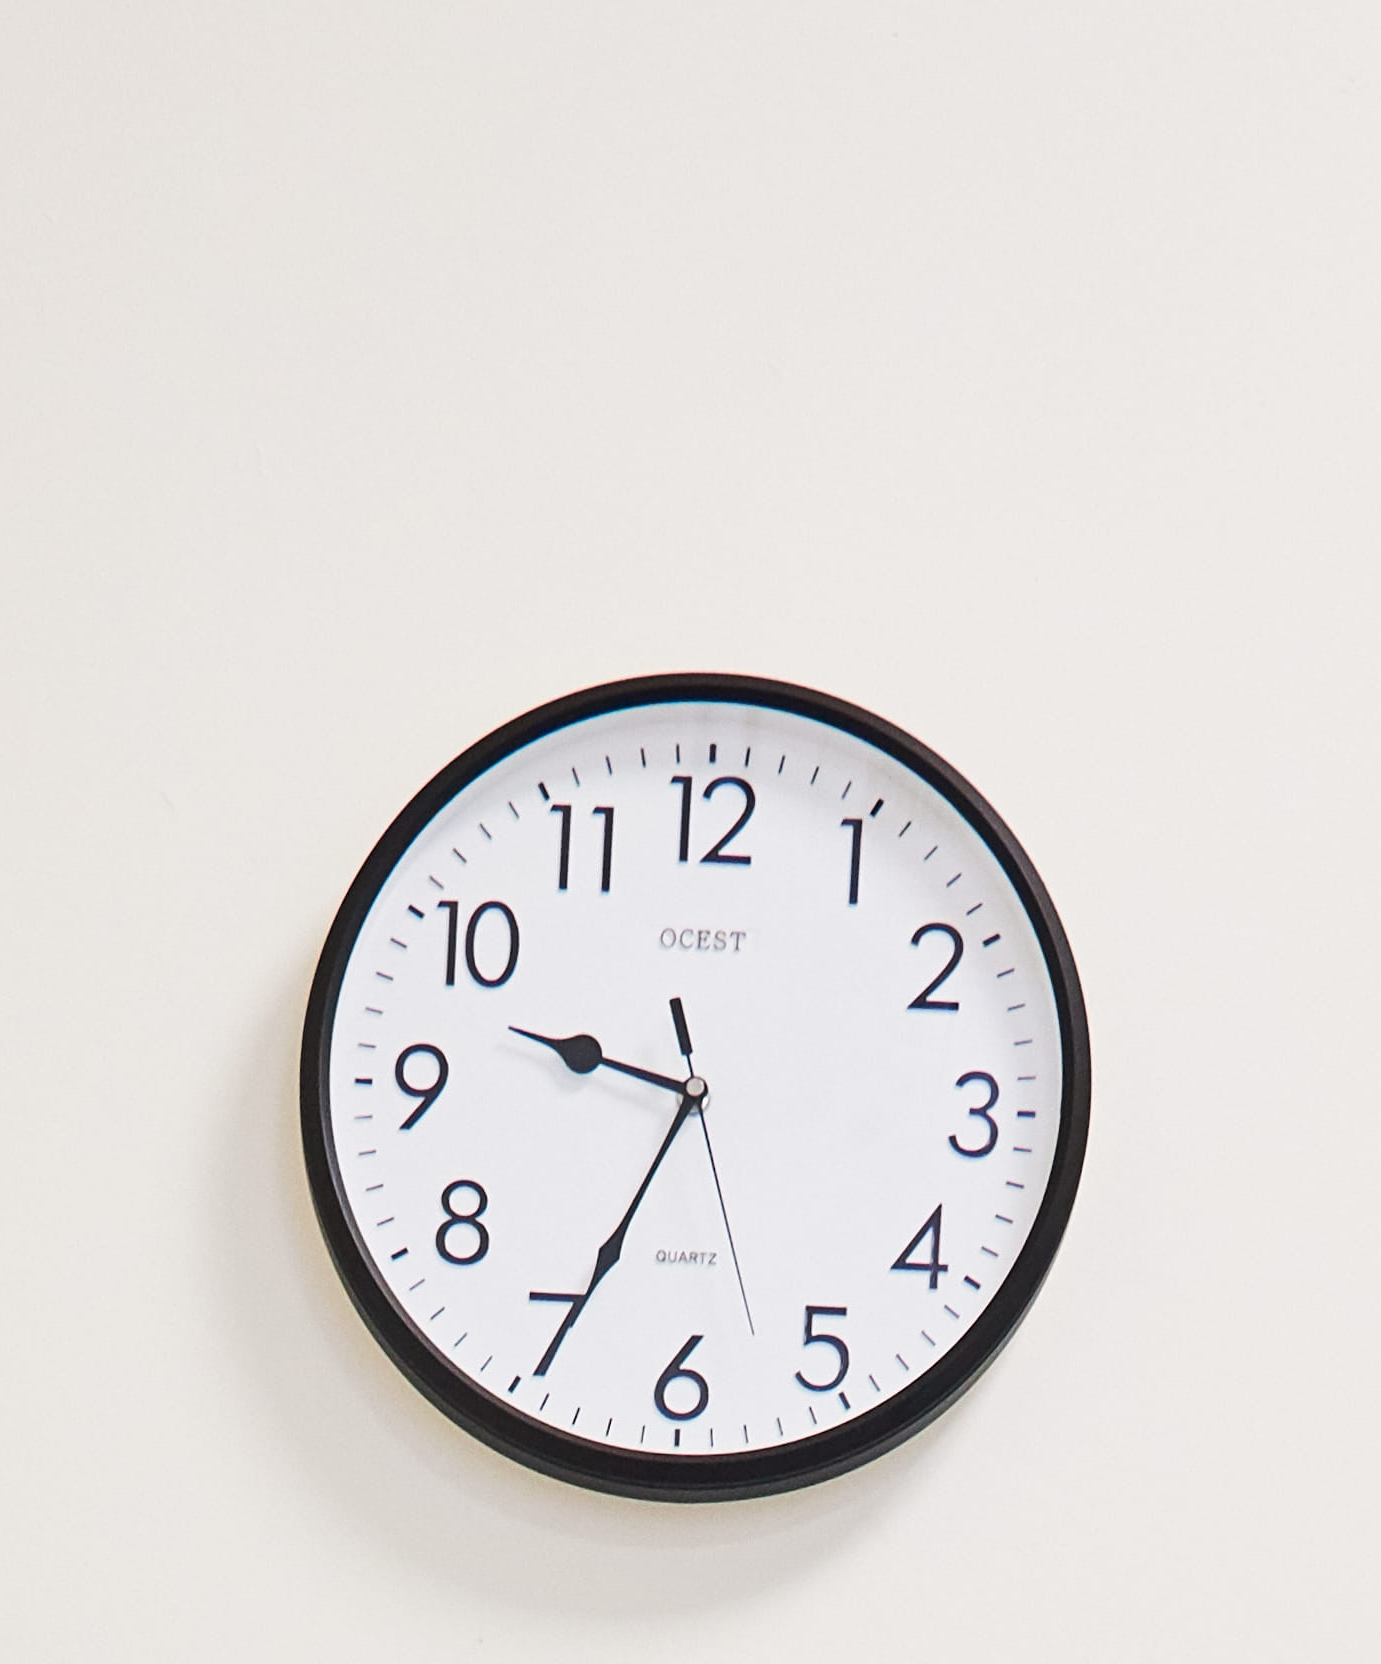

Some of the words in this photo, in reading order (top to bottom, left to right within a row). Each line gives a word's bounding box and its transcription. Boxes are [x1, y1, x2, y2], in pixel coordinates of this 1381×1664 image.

[551, 804, 616, 892] 11
[671, 775, 757, 866] 12
[841, 818, 864, 905] 1
[437, 900, 521, 988] 10
[660, 928, 747, 951] OCEST
[907, 923, 965, 1011] 2
[395, 1044, 449, 1131] 9
[948, 1072, 1000, 1158] 3
[435, 1180, 490, 1265] 8
[656, 1249, 717, 1265] QUARTZ
[891, 1203, 949, 1290] 4
[529, 1292, 586, 1377] 7
[795, 1306, 850, 1392] 5
[653, 1335, 709, 1421] 6
